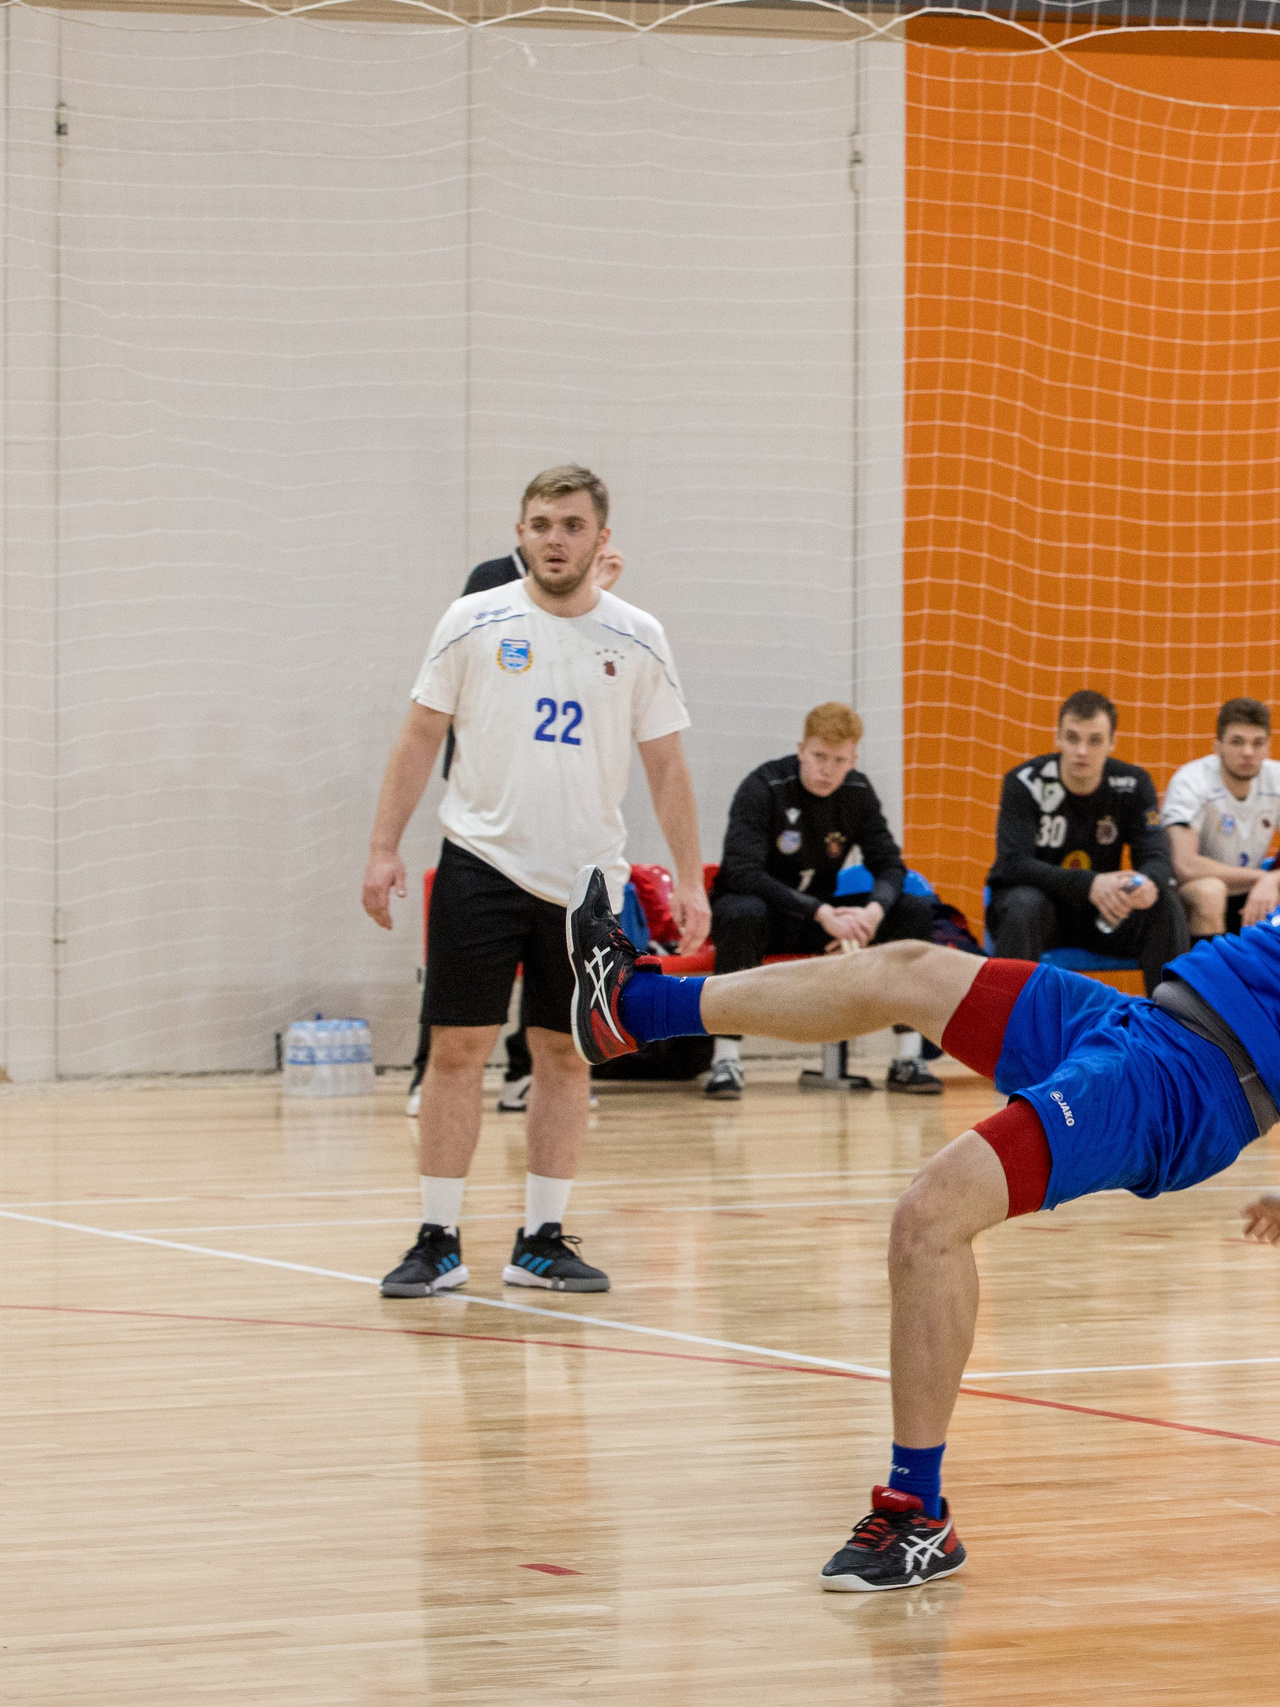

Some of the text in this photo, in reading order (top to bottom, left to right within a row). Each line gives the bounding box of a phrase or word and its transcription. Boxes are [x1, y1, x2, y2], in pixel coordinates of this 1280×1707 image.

[534, 697, 583, 746] 22
[1034, 814, 1067, 848] 30
[1057, 1101, 1075, 1127] JAKO
